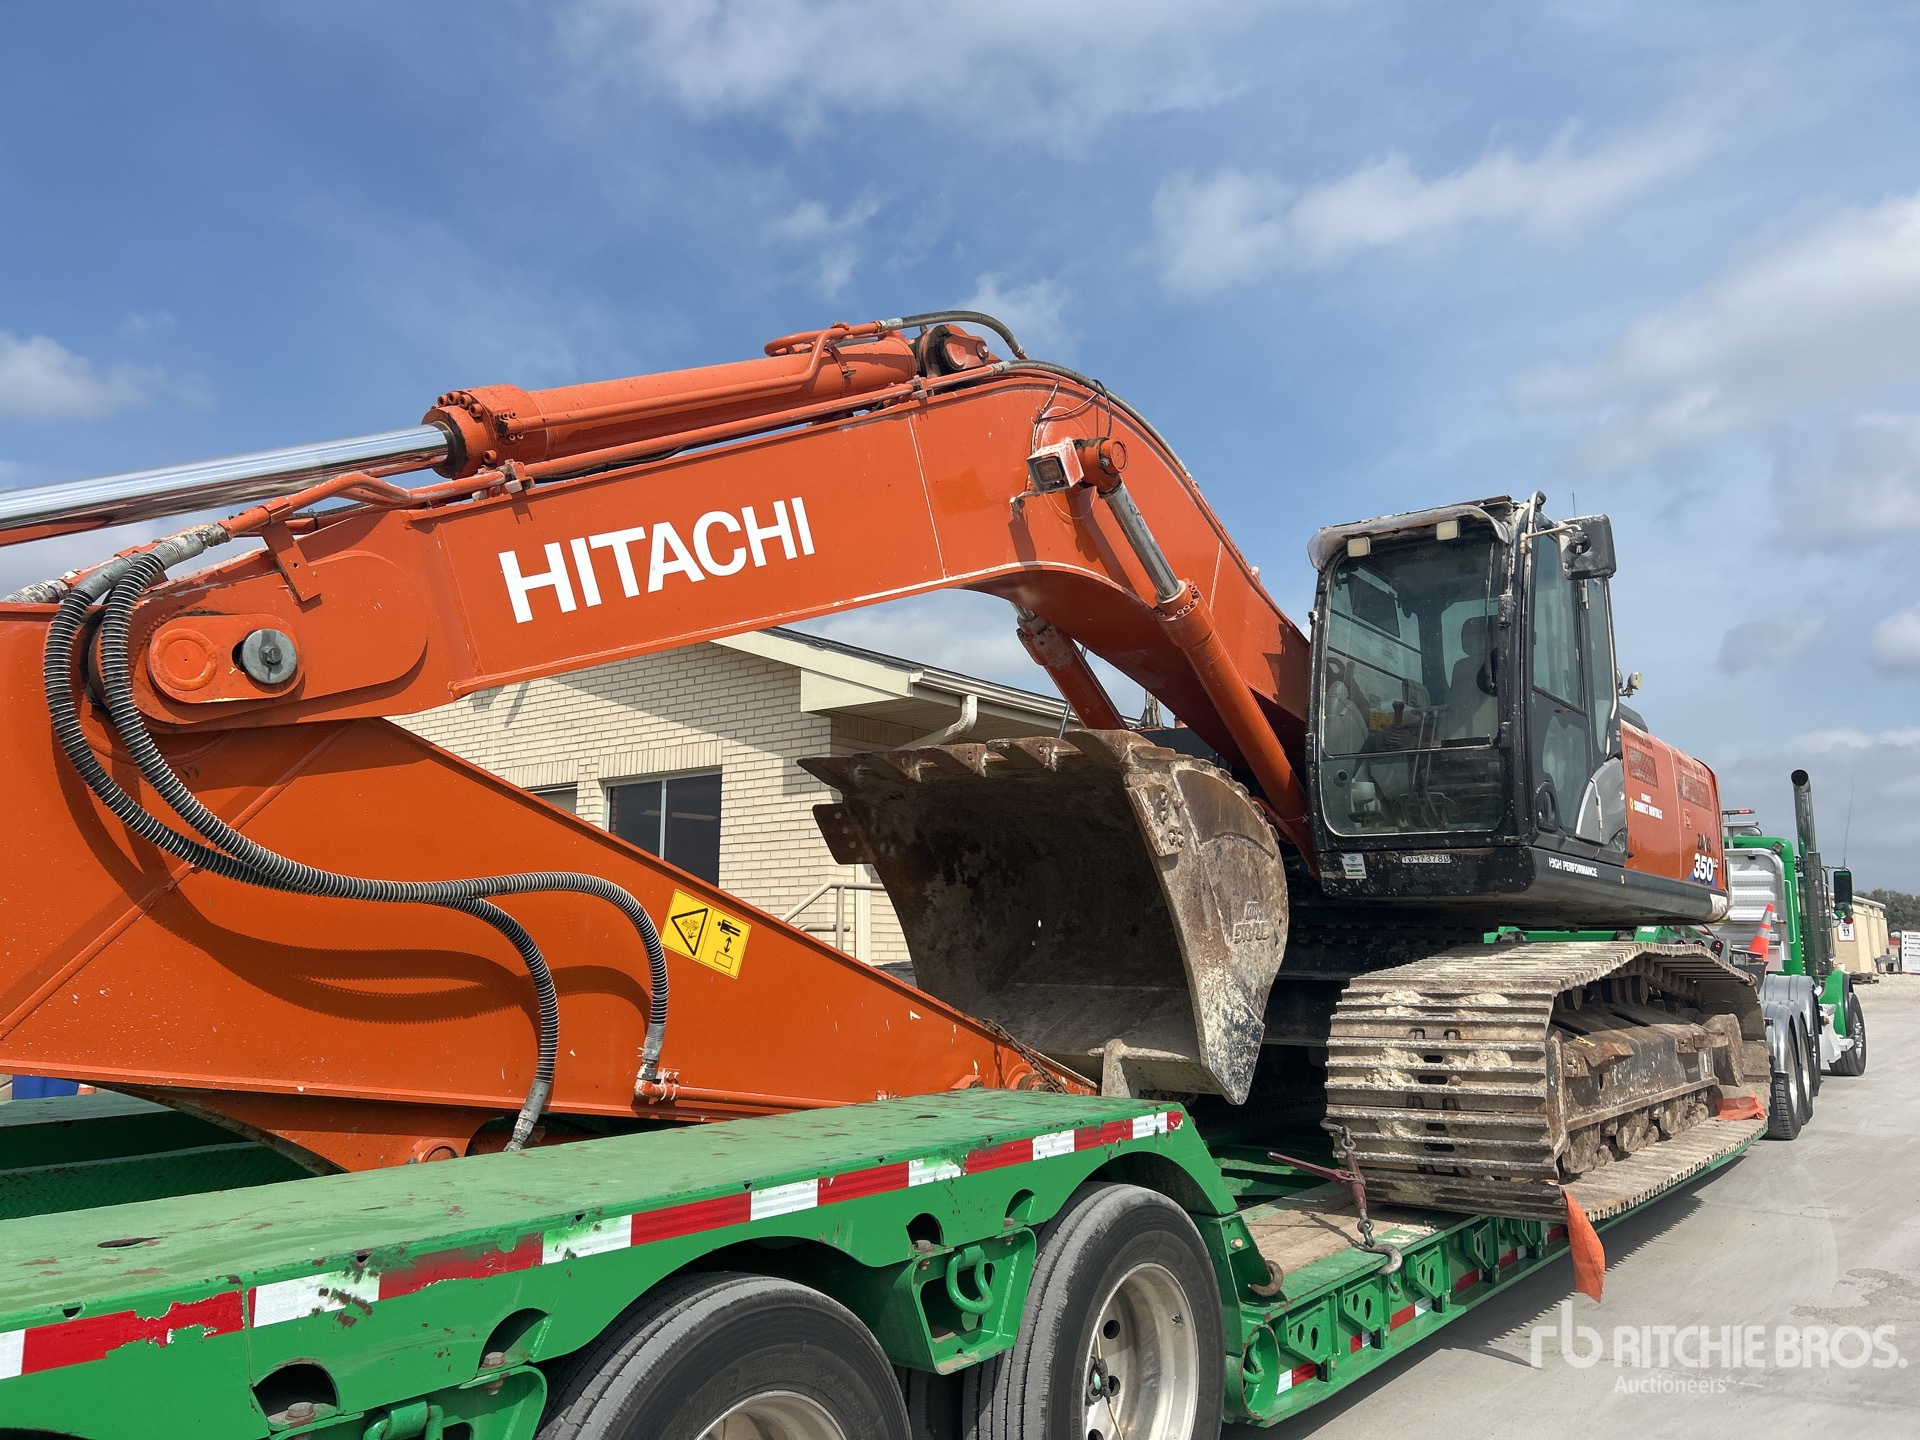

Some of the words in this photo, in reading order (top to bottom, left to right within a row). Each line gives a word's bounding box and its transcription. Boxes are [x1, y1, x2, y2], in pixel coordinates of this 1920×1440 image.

[498, 496, 816, 624] HITACHI
[1548, 856, 1563, 871] HIGH
[1563, 860, 1599, 878] PERFORMANCE
